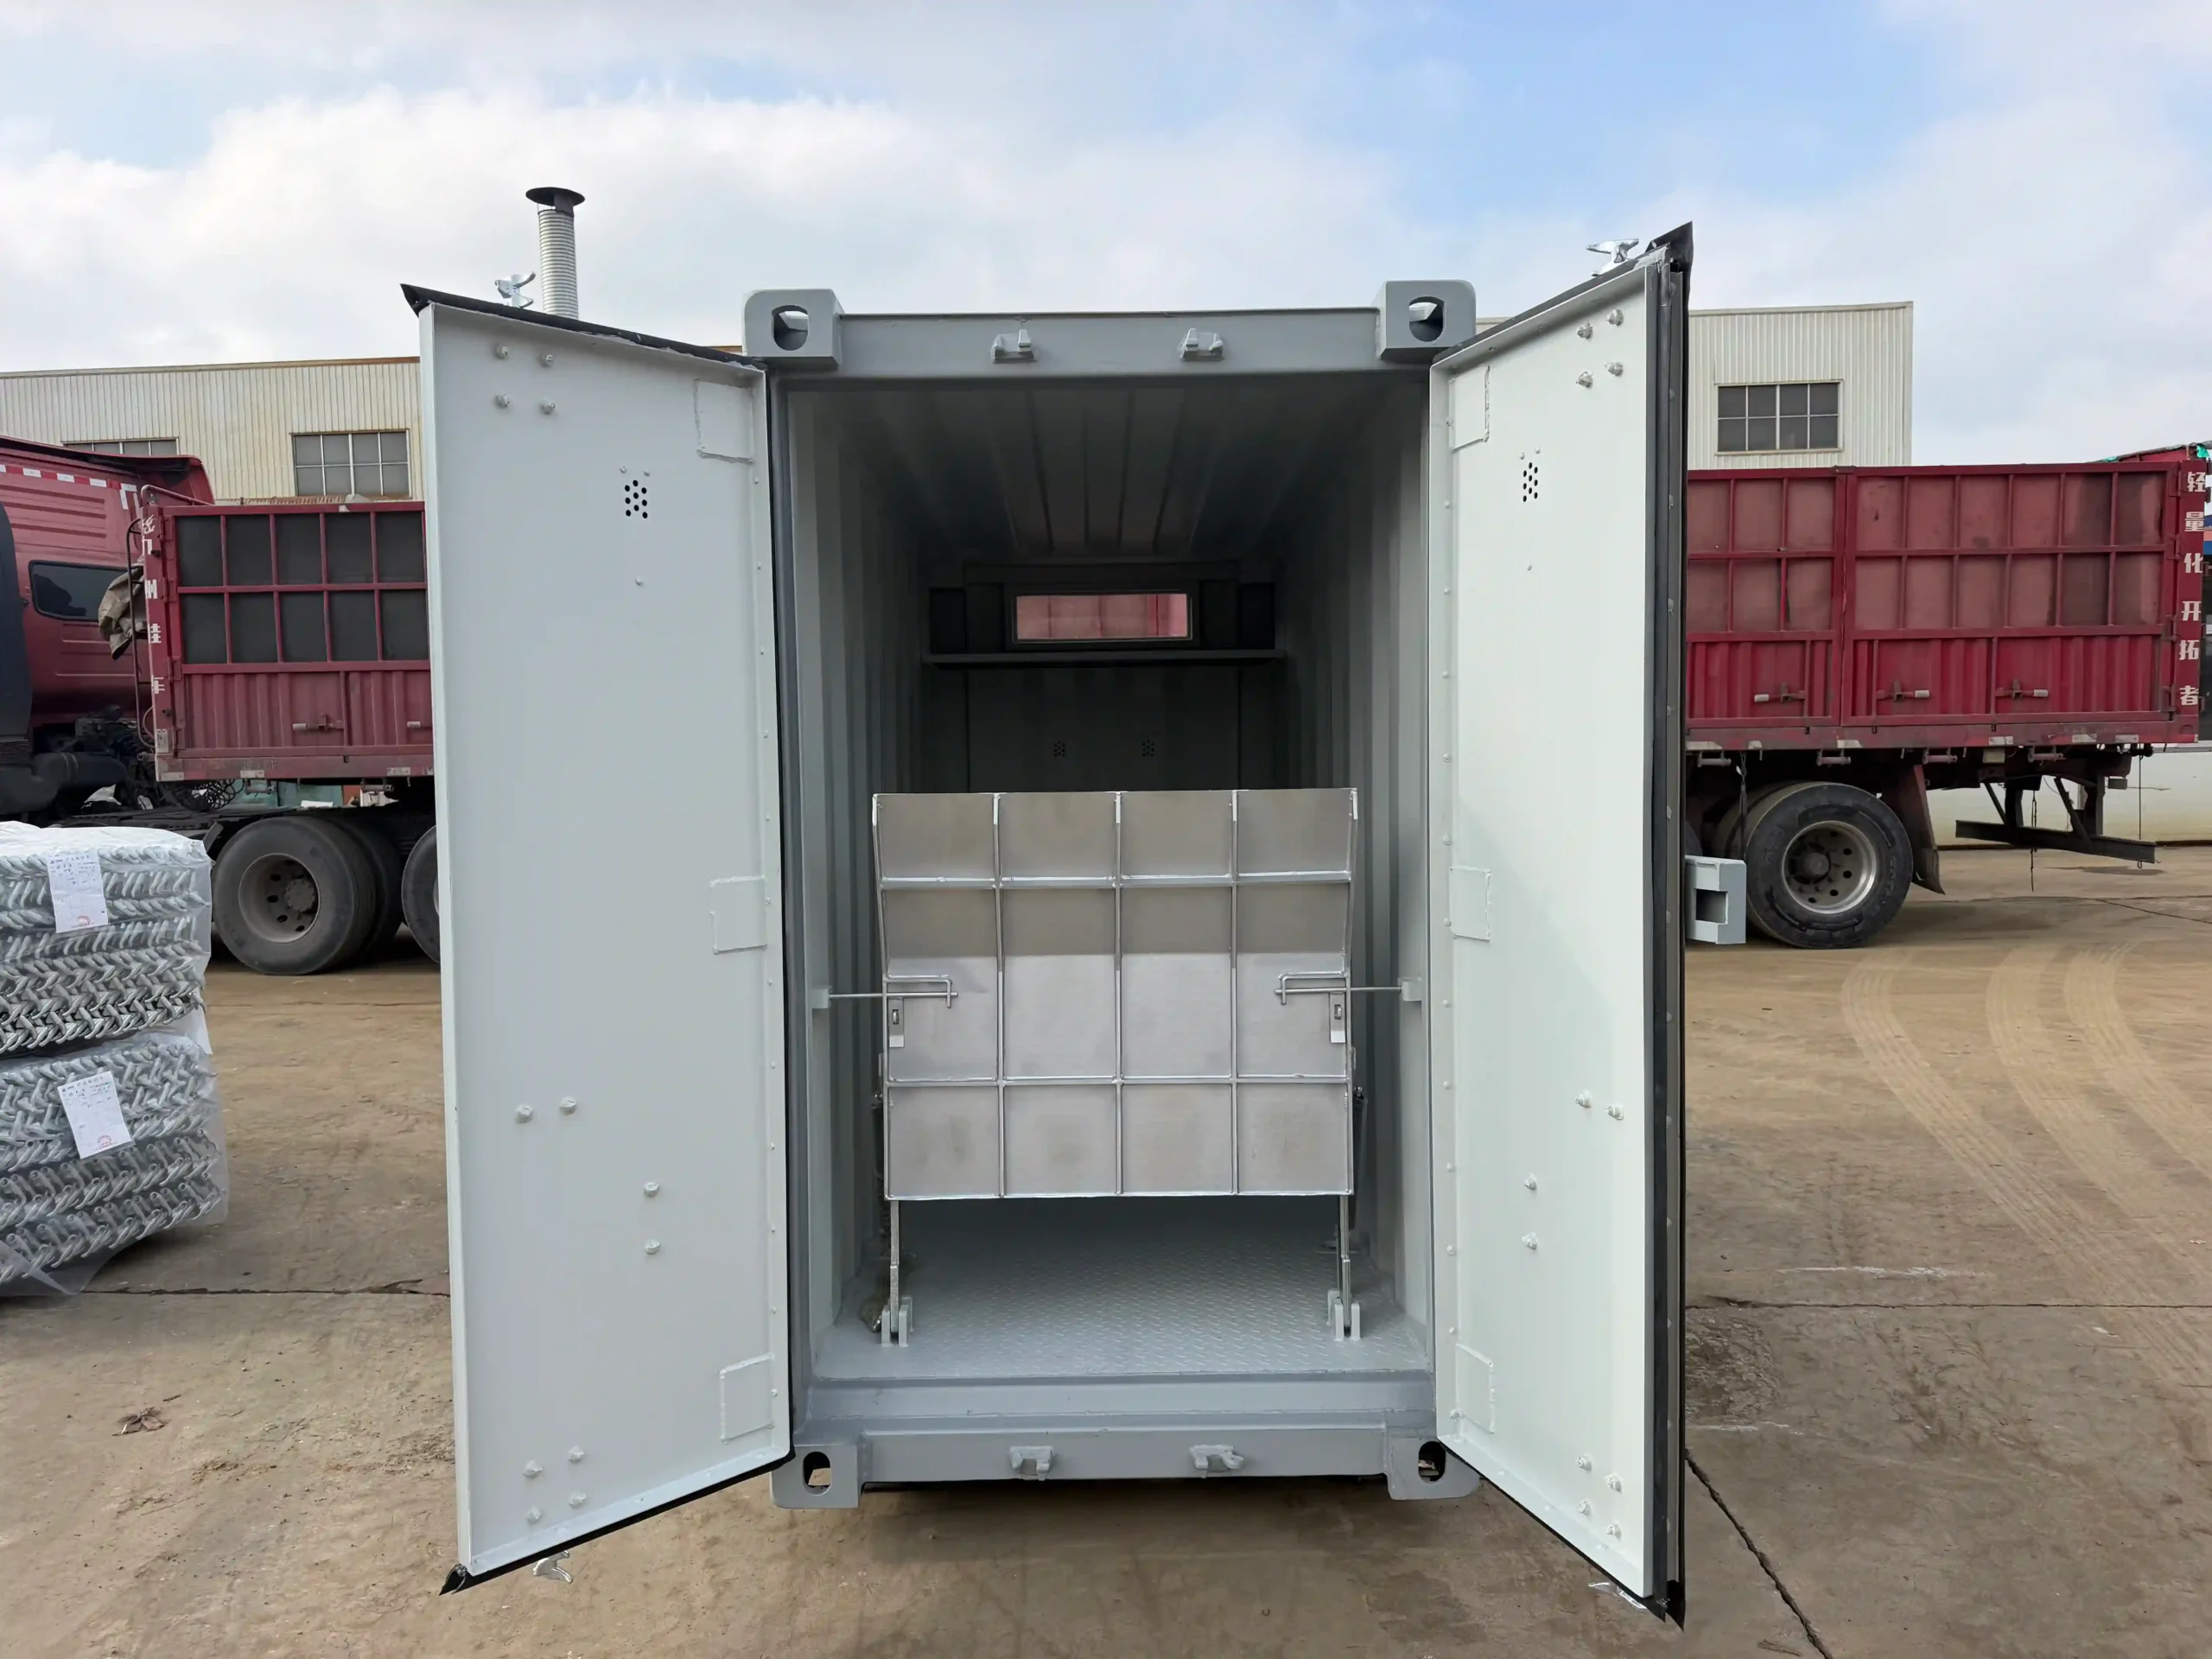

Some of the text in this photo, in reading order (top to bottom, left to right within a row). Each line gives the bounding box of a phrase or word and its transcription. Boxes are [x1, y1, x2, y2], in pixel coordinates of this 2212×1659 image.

[2179, 471, 2206, 706] 轻量化开拓者
